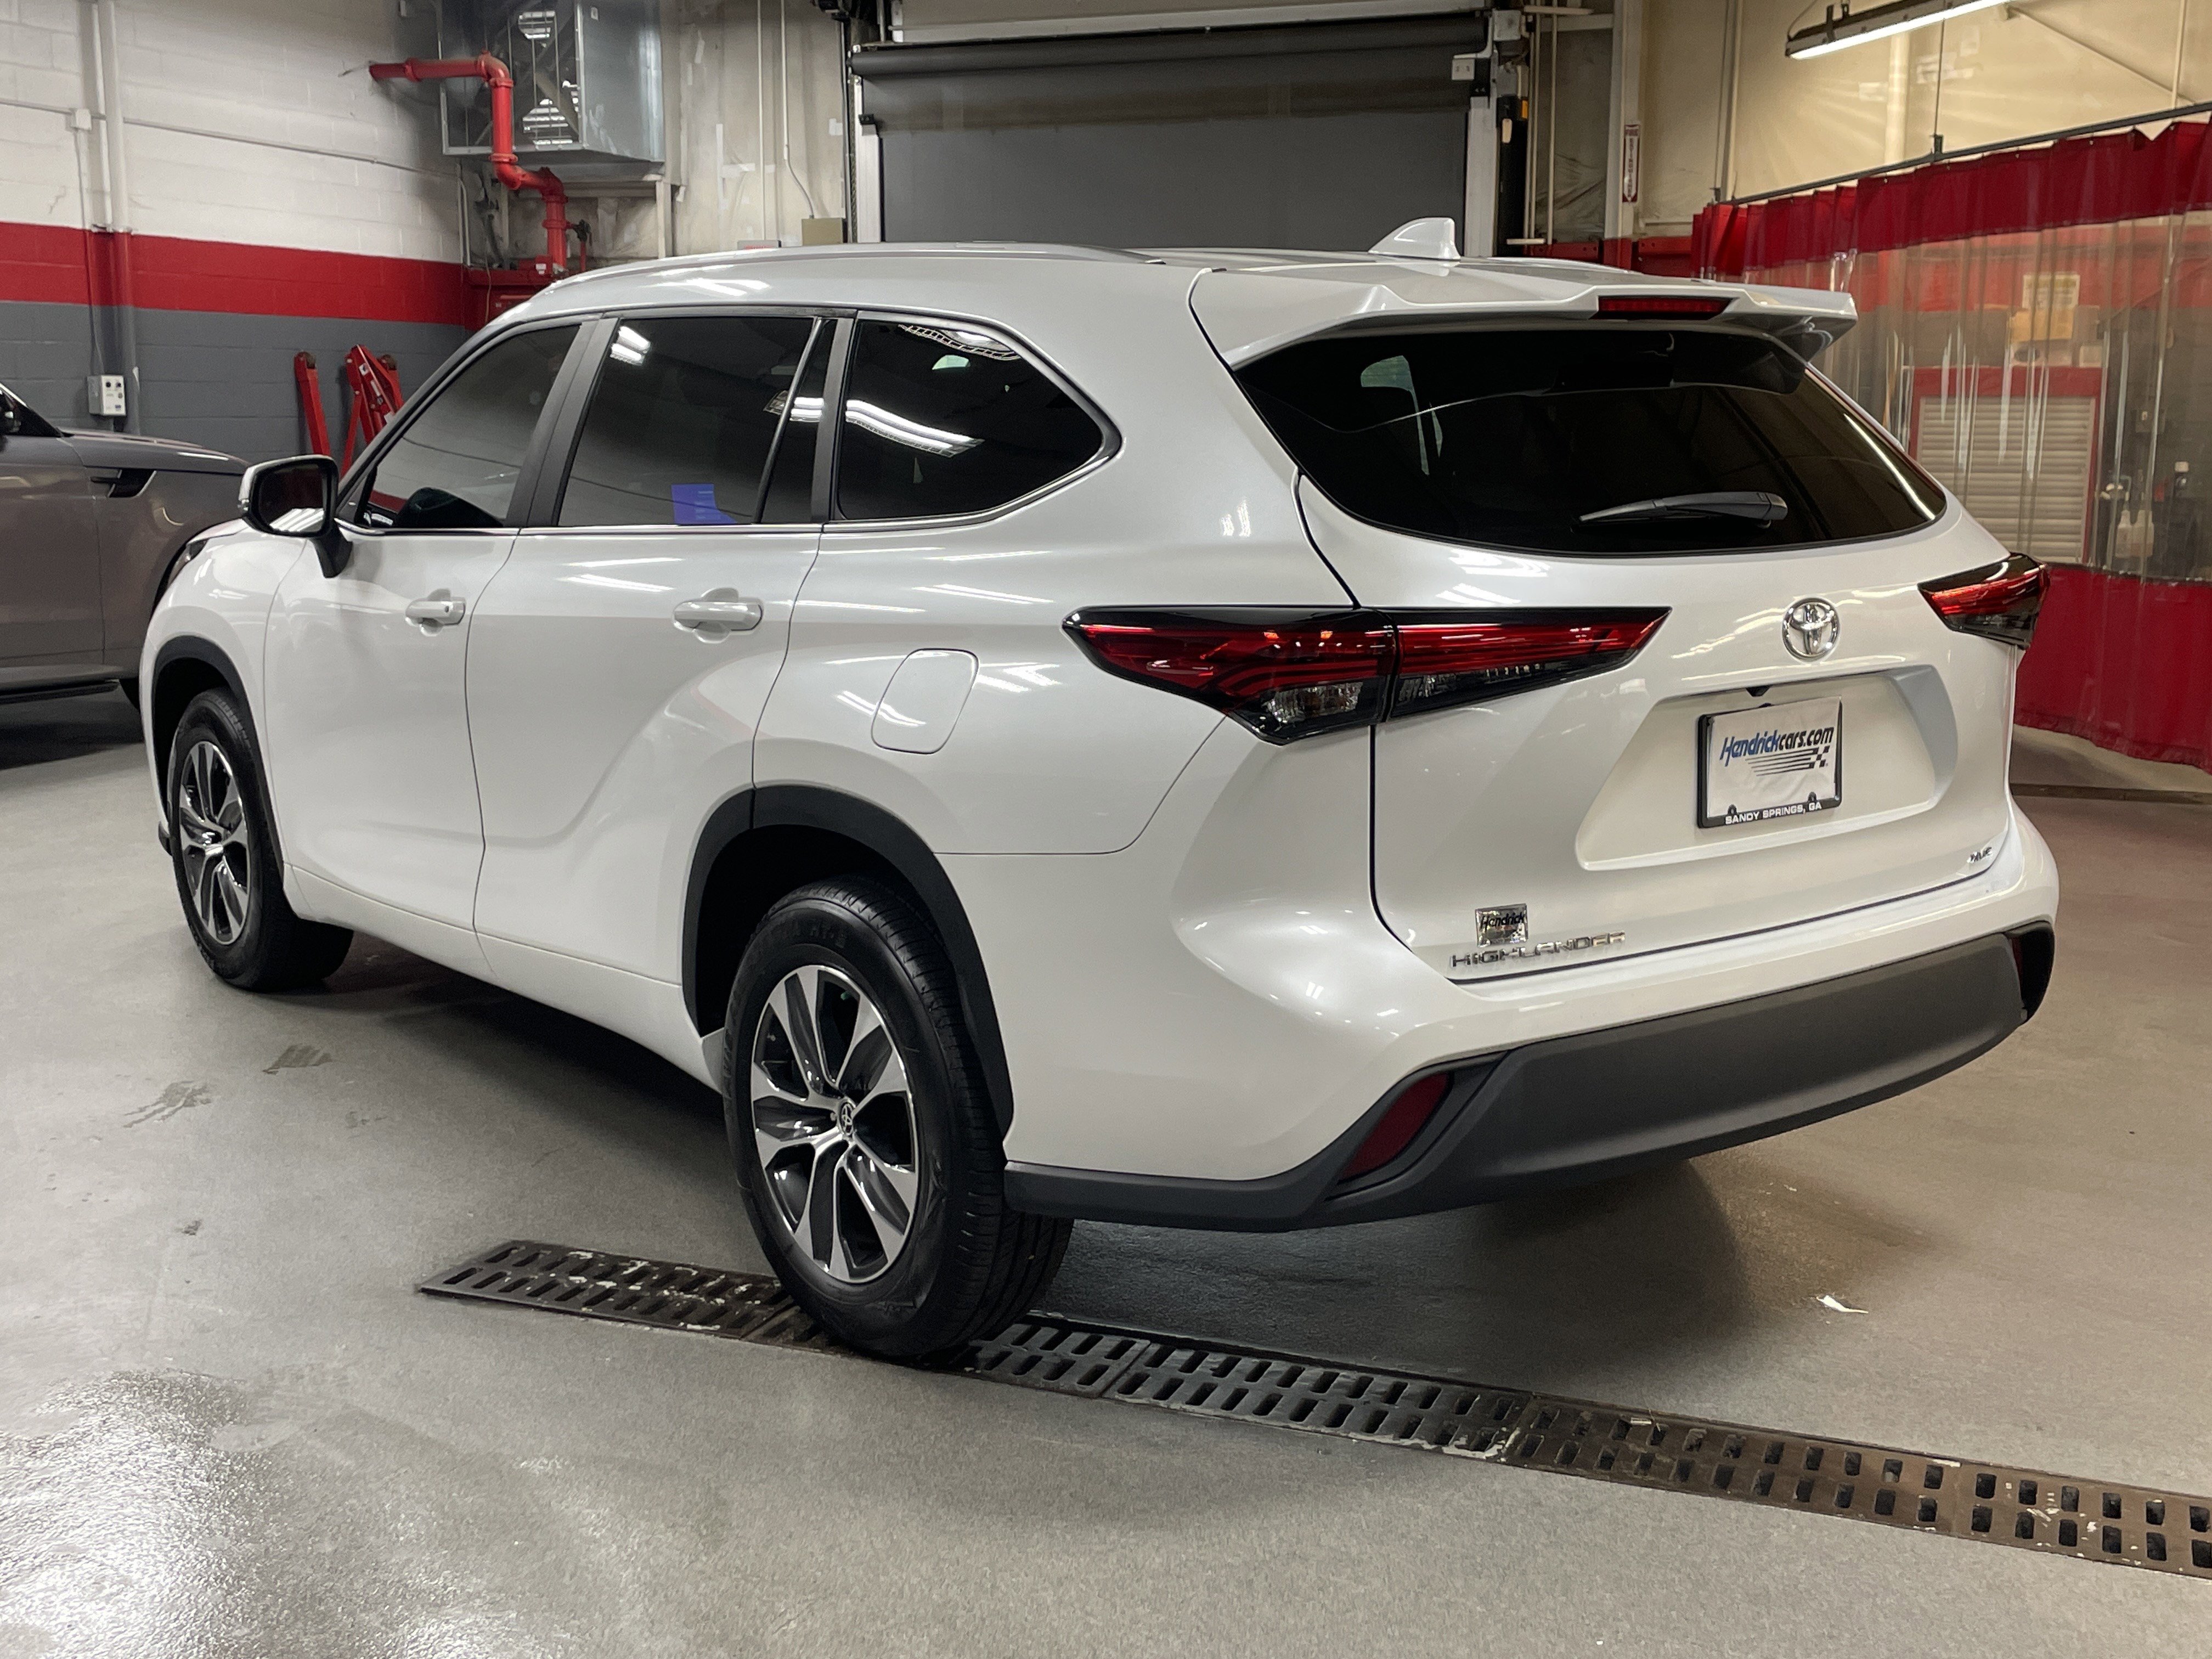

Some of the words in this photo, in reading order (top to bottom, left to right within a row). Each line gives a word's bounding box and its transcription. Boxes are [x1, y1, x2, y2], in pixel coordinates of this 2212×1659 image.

[1719, 726, 1835, 767] Hendrickcars.com
[1725, 811, 1760, 825] SANDY
[1762, 804, 1806, 819] SPRINGS,
[1808, 802, 1822, 811] GA
[1451, 930, 1626, 967] HIGHLANDER
